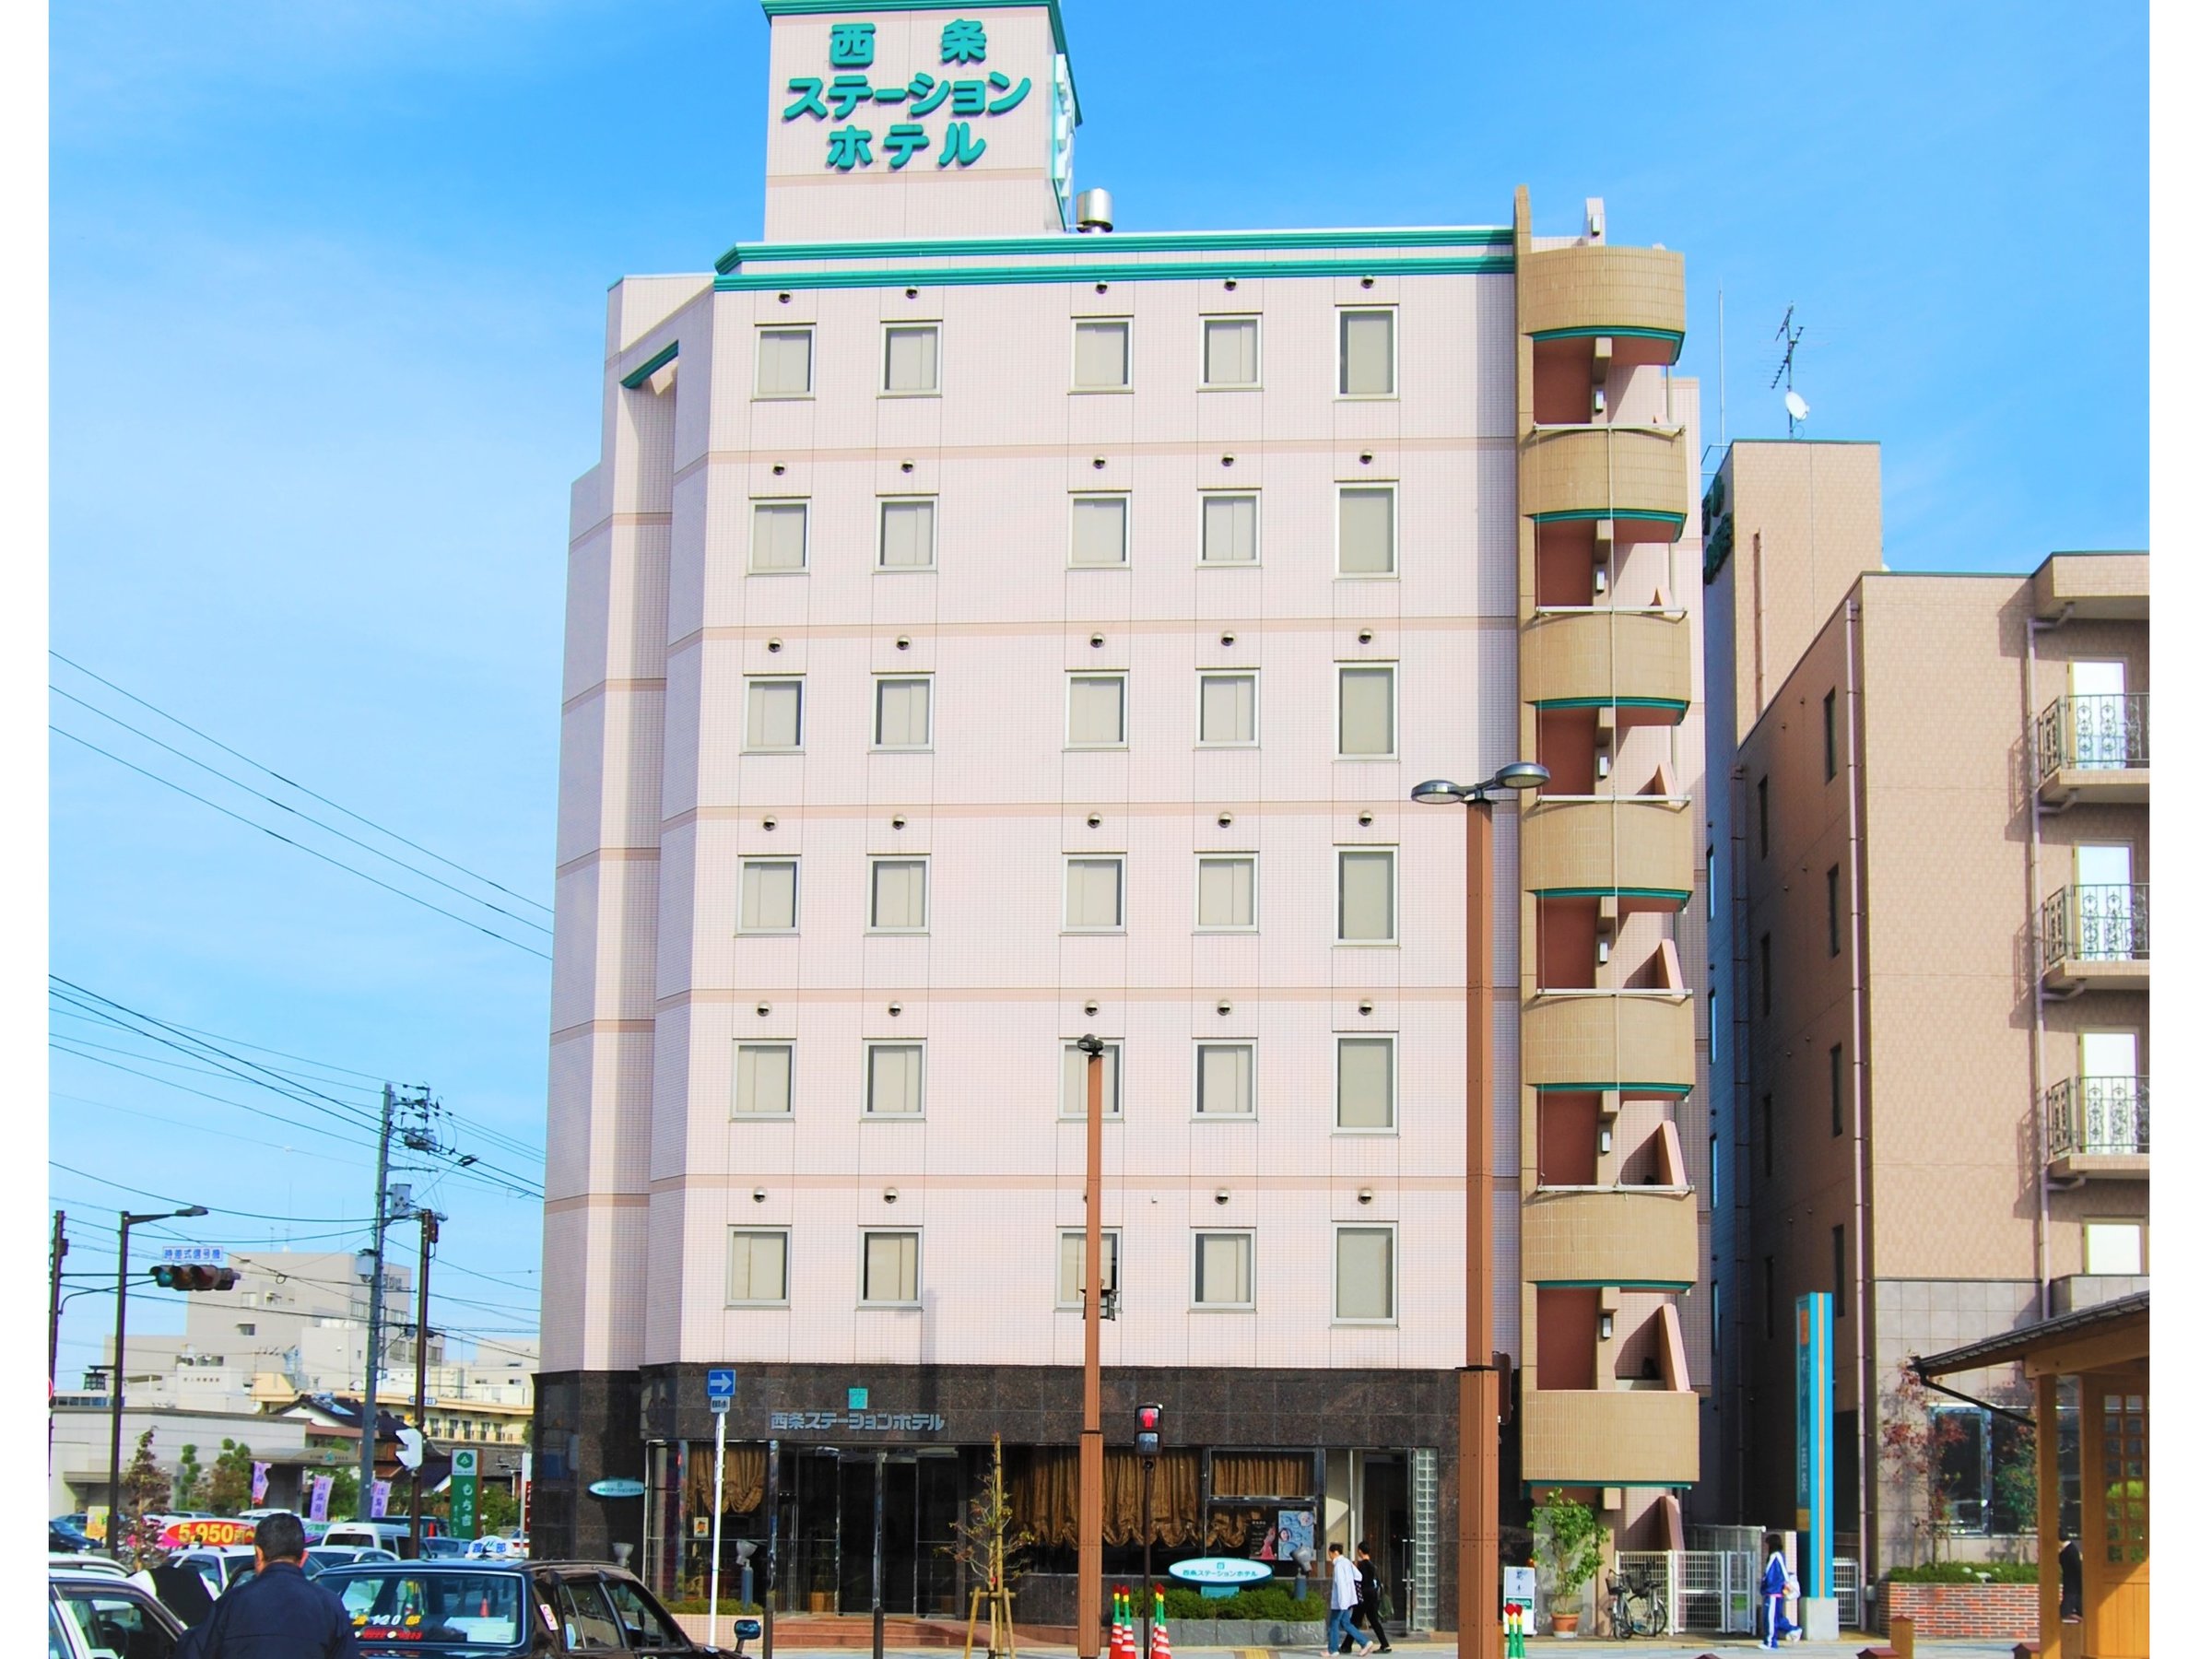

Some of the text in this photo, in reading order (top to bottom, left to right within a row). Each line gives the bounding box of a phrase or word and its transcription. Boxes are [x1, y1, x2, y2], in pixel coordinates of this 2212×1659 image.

[783, 71, 1032, 121] ステーション
[828, 122, 987, 171] ホテル
[771, 1412, 945, 1430] 西条ステーションホテル
